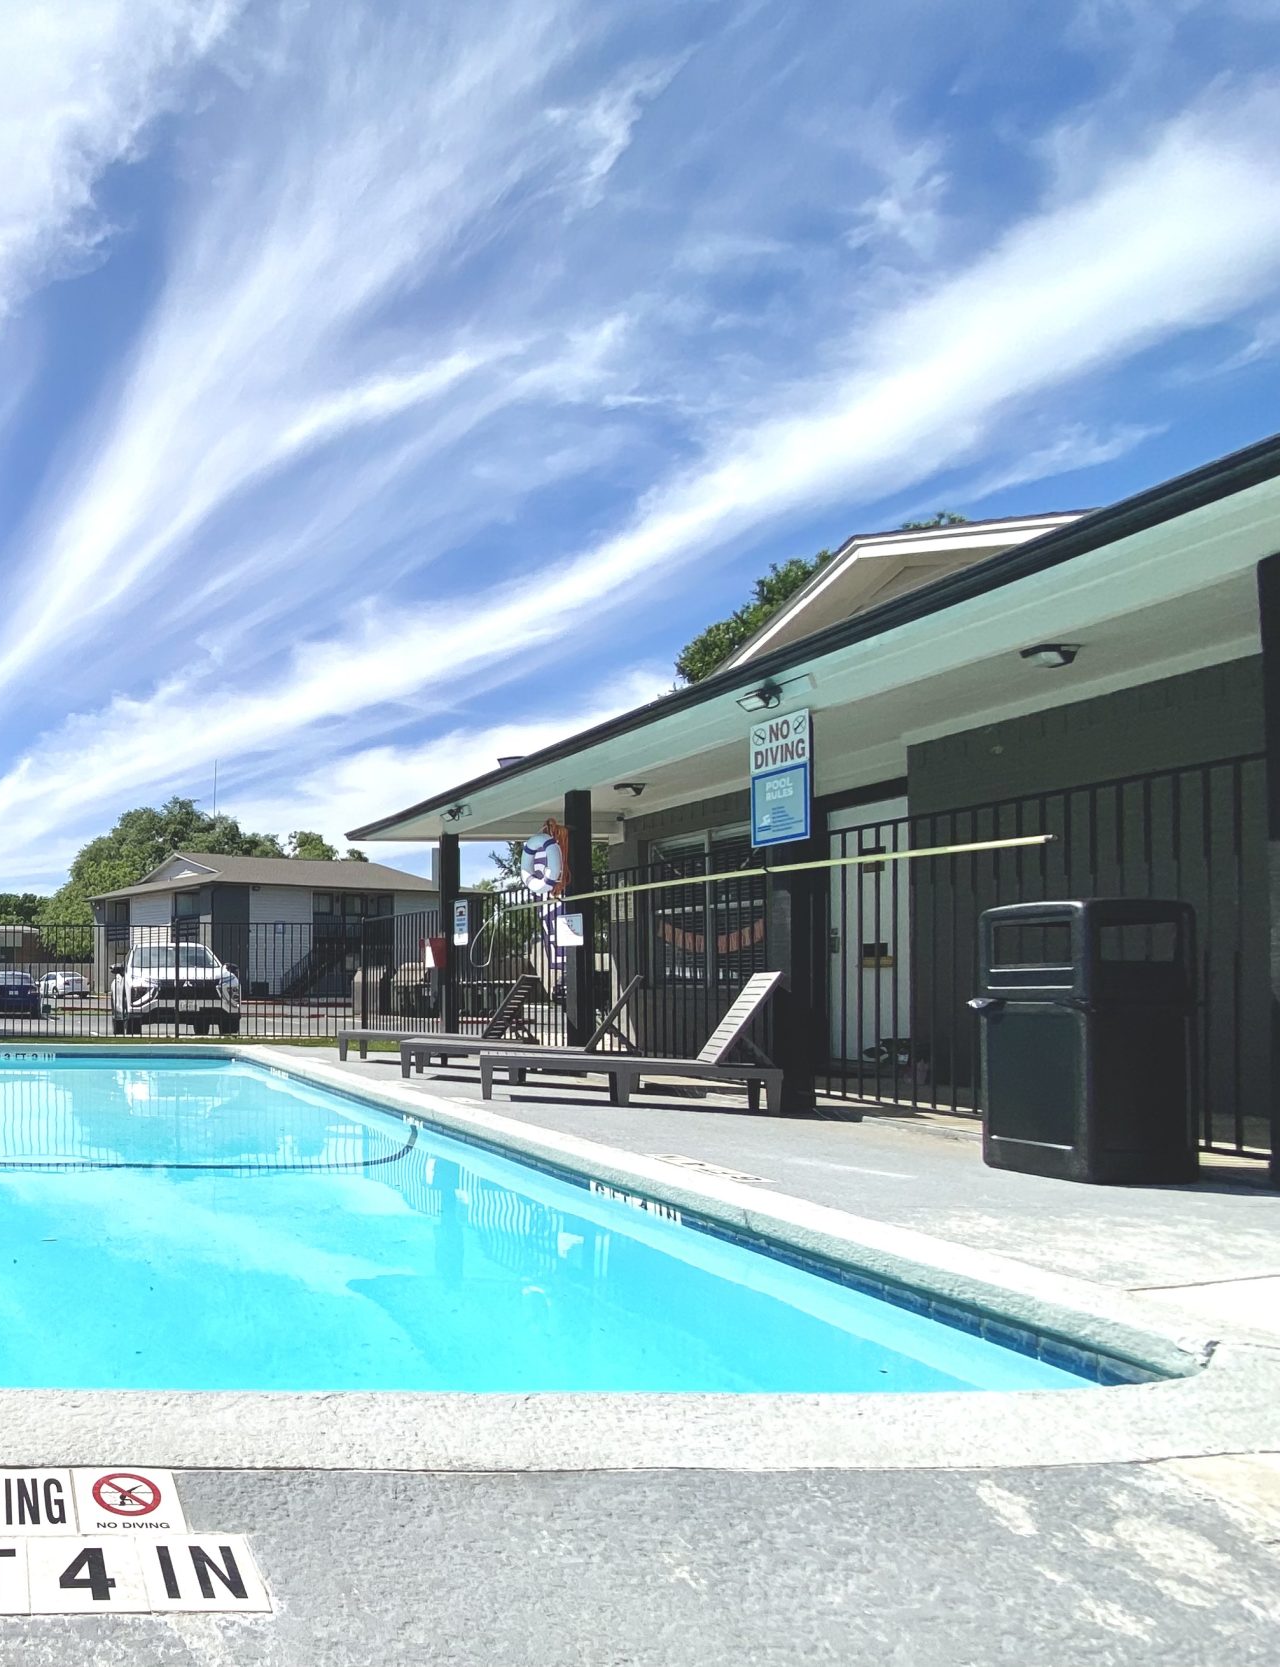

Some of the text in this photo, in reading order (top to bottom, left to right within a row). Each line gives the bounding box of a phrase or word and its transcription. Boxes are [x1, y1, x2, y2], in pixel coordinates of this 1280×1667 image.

[769, 719, 790, 743] NO
[754, 738, 806, 770] DIVING
[765, 776, 793, 793] POOL
[765, 786, 794, 801] RULES
[58, 1547, 116, 1601] 4
[156, 1545, 249, 1600] IN
